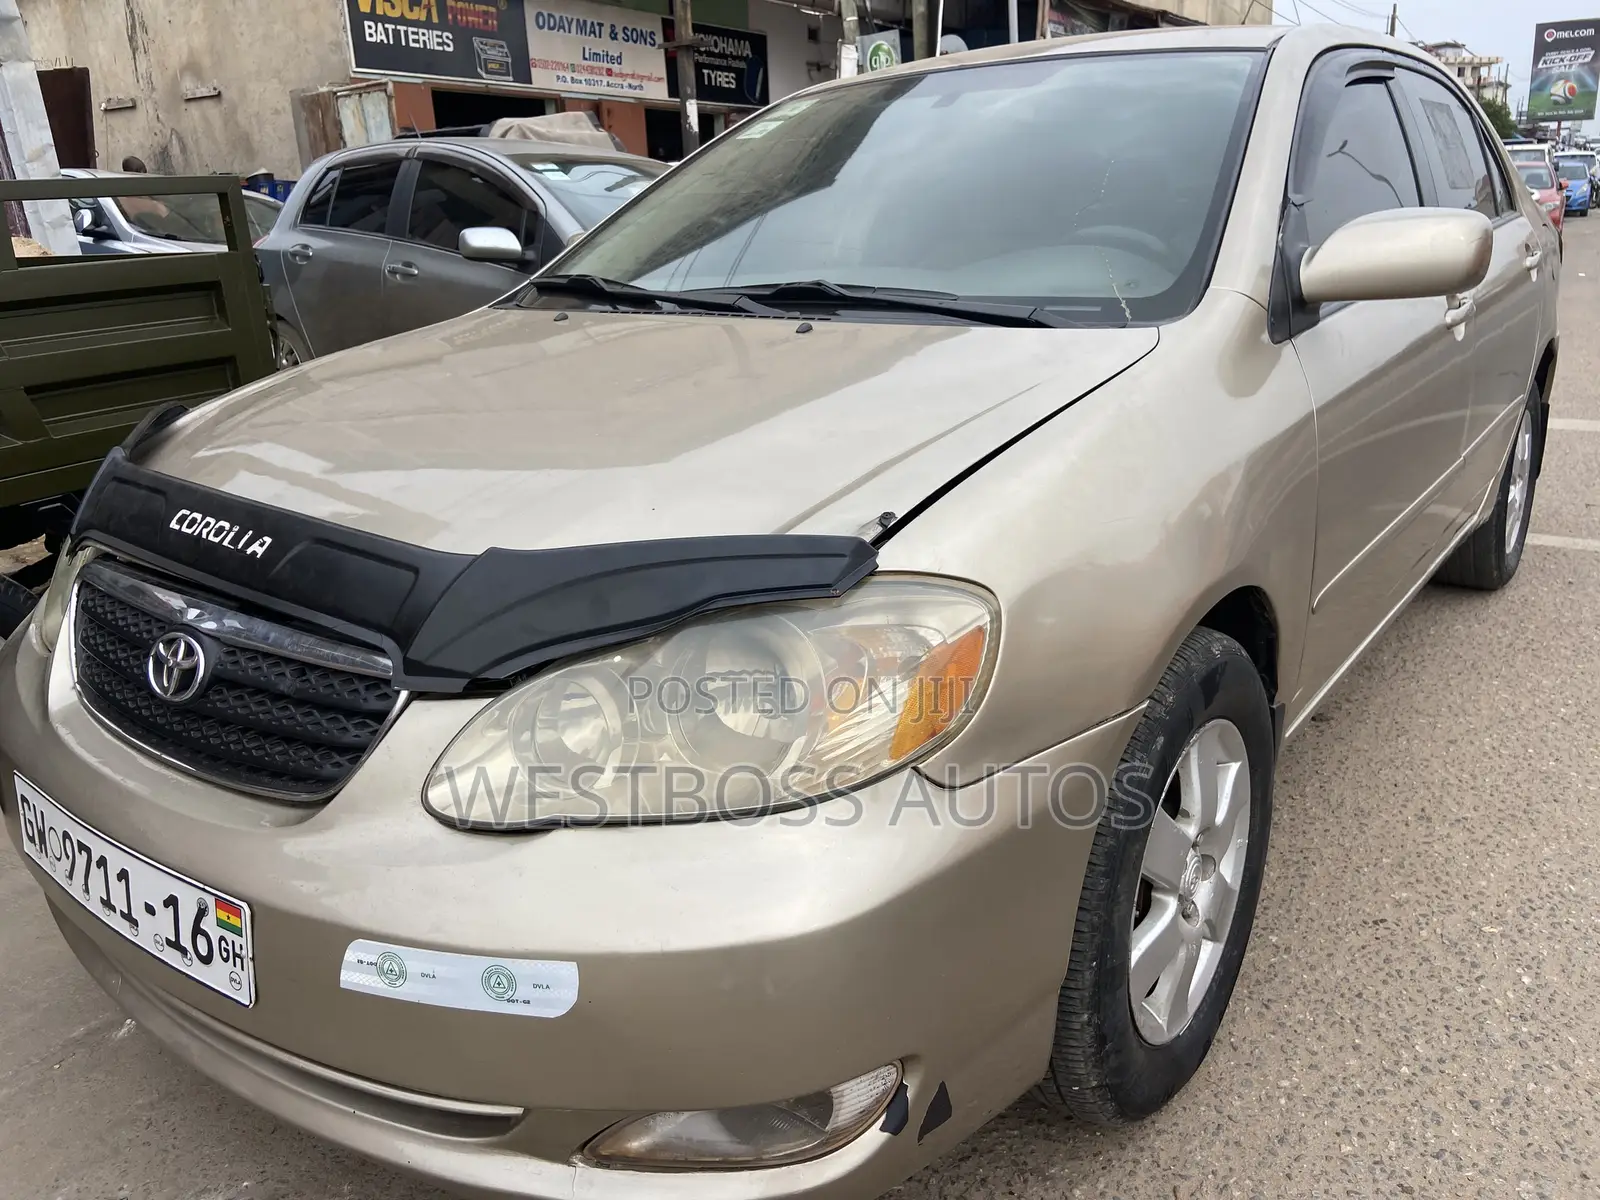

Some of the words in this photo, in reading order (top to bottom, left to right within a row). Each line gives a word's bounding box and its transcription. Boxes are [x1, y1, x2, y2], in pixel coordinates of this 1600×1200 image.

[446, 0, 499, 32] POWER
[534, 10, 605, 39] ODAYMAT
[608, 24, 619, 41] &
[621, 27, 657, 48] SONS
[363, 20, 455, 52] BATTERIES
[582, 47, 623, 66] Limited
[702, 68, 736, 89] TYRES
[20, 793, 49, 859] GW
[218, 935, 245, 971] GH
[420, 972, 437, 980] DVLA
